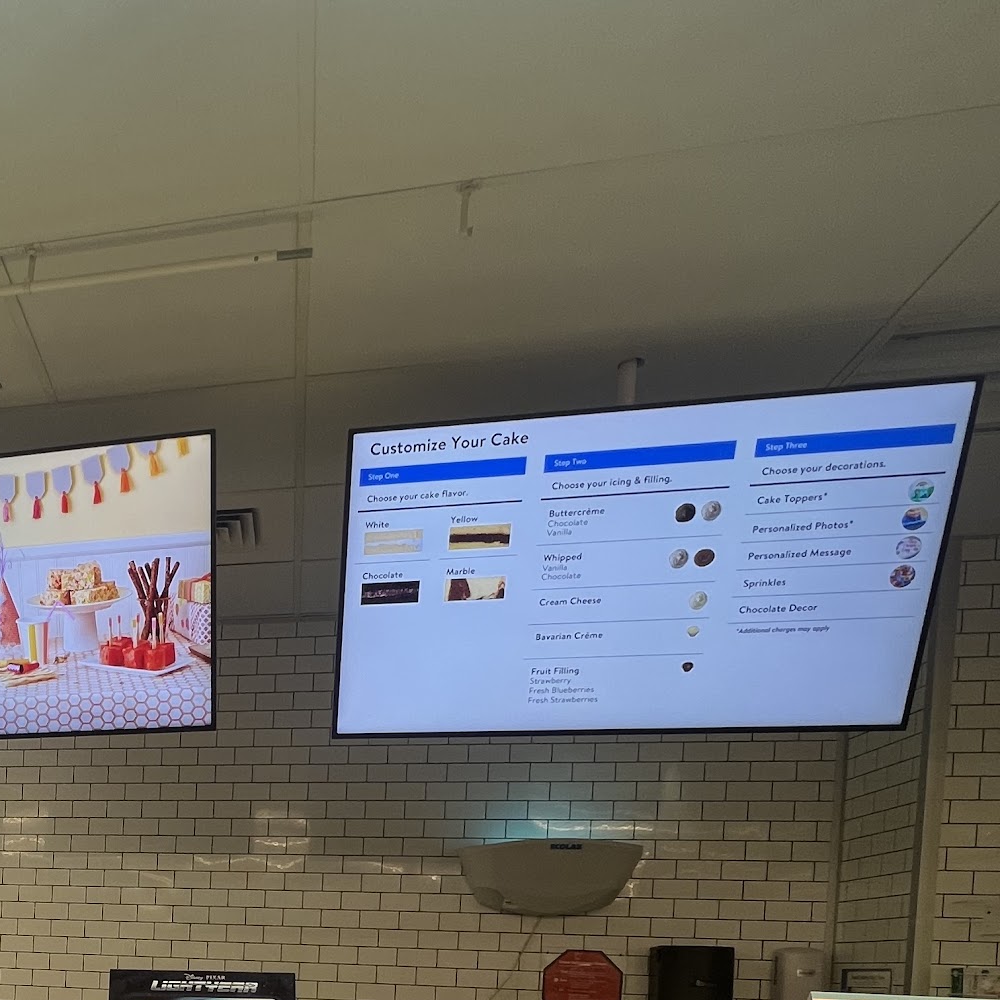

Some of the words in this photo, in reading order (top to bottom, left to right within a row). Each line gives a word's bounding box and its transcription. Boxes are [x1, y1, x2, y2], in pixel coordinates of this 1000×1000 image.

[371, 439, 447, 456] Customize
[451, 436, 486, 451] Your
[491, 432, 529, 447] Cake
[765, 443, 783, 453] Step
[785, 442, 808, 451] Three
[554, 459, 571, 469] Step
[572, 458, 587, 467] Two
[762, 466, 797, 477] Choose
[800, 464, 823, 478] your
[825, 460, 886, 473] decorations.
[368, 473, 384, 482] Step
[385, 472, 400, 480] One
[551, 481, 584, 491] Choose
[587, 481, 607, 492] your
[609, 477, 632, 488] icing
[634, 476, 641, 485] &
[643, 475, 673, 486] filling.
[367, 494, 397, 504] Choose
[399, 494, 418, 506] your
[420, 491, 440, 500] cake
[442, 489, 469, 499] flavor.
[757, 496, 781, 505] Cake
[451, 516, 478, 525] Yellow
[547, 519, 588, 528] Chocolate
[365, 521, 390, 530] White
[752, 522, 812, 533] Personalized
[546, 529, 572, 537] Vanilla
[543, 552, 582, 564] Whipped
[748, 549, 807, 561] Personalized
[810, 548, 852, 558] Message
[446, 568, 475, 577] Marble
[542, 564, 568, 572] Vanilla
[362, 572, 403, 581] Chocolate
[541, 572, 582, 580] Chocolate
[743, 578, 786, 589] Sprinkles
[570, 597, 601, 605] Cheese
[739, 605, 786, 615] Chocolate
[789, 603, 818, 613] Decor
[797, 627, 811, 635] may
[813, 626, 830, 634] apply
[535, 633, 572, 641] Bavarian
[531, 667, 551, 676] Fruit
[553, 667, 579, 677] Filling
[530, 678, 571, 686] Strawberry
[529, 687, 549, 695] Fresh
[551, 686, 595, 694] Blueberries
[550, 696, 598, 704] Strawberries
[551, 842, 582, 851] ECOLAB
